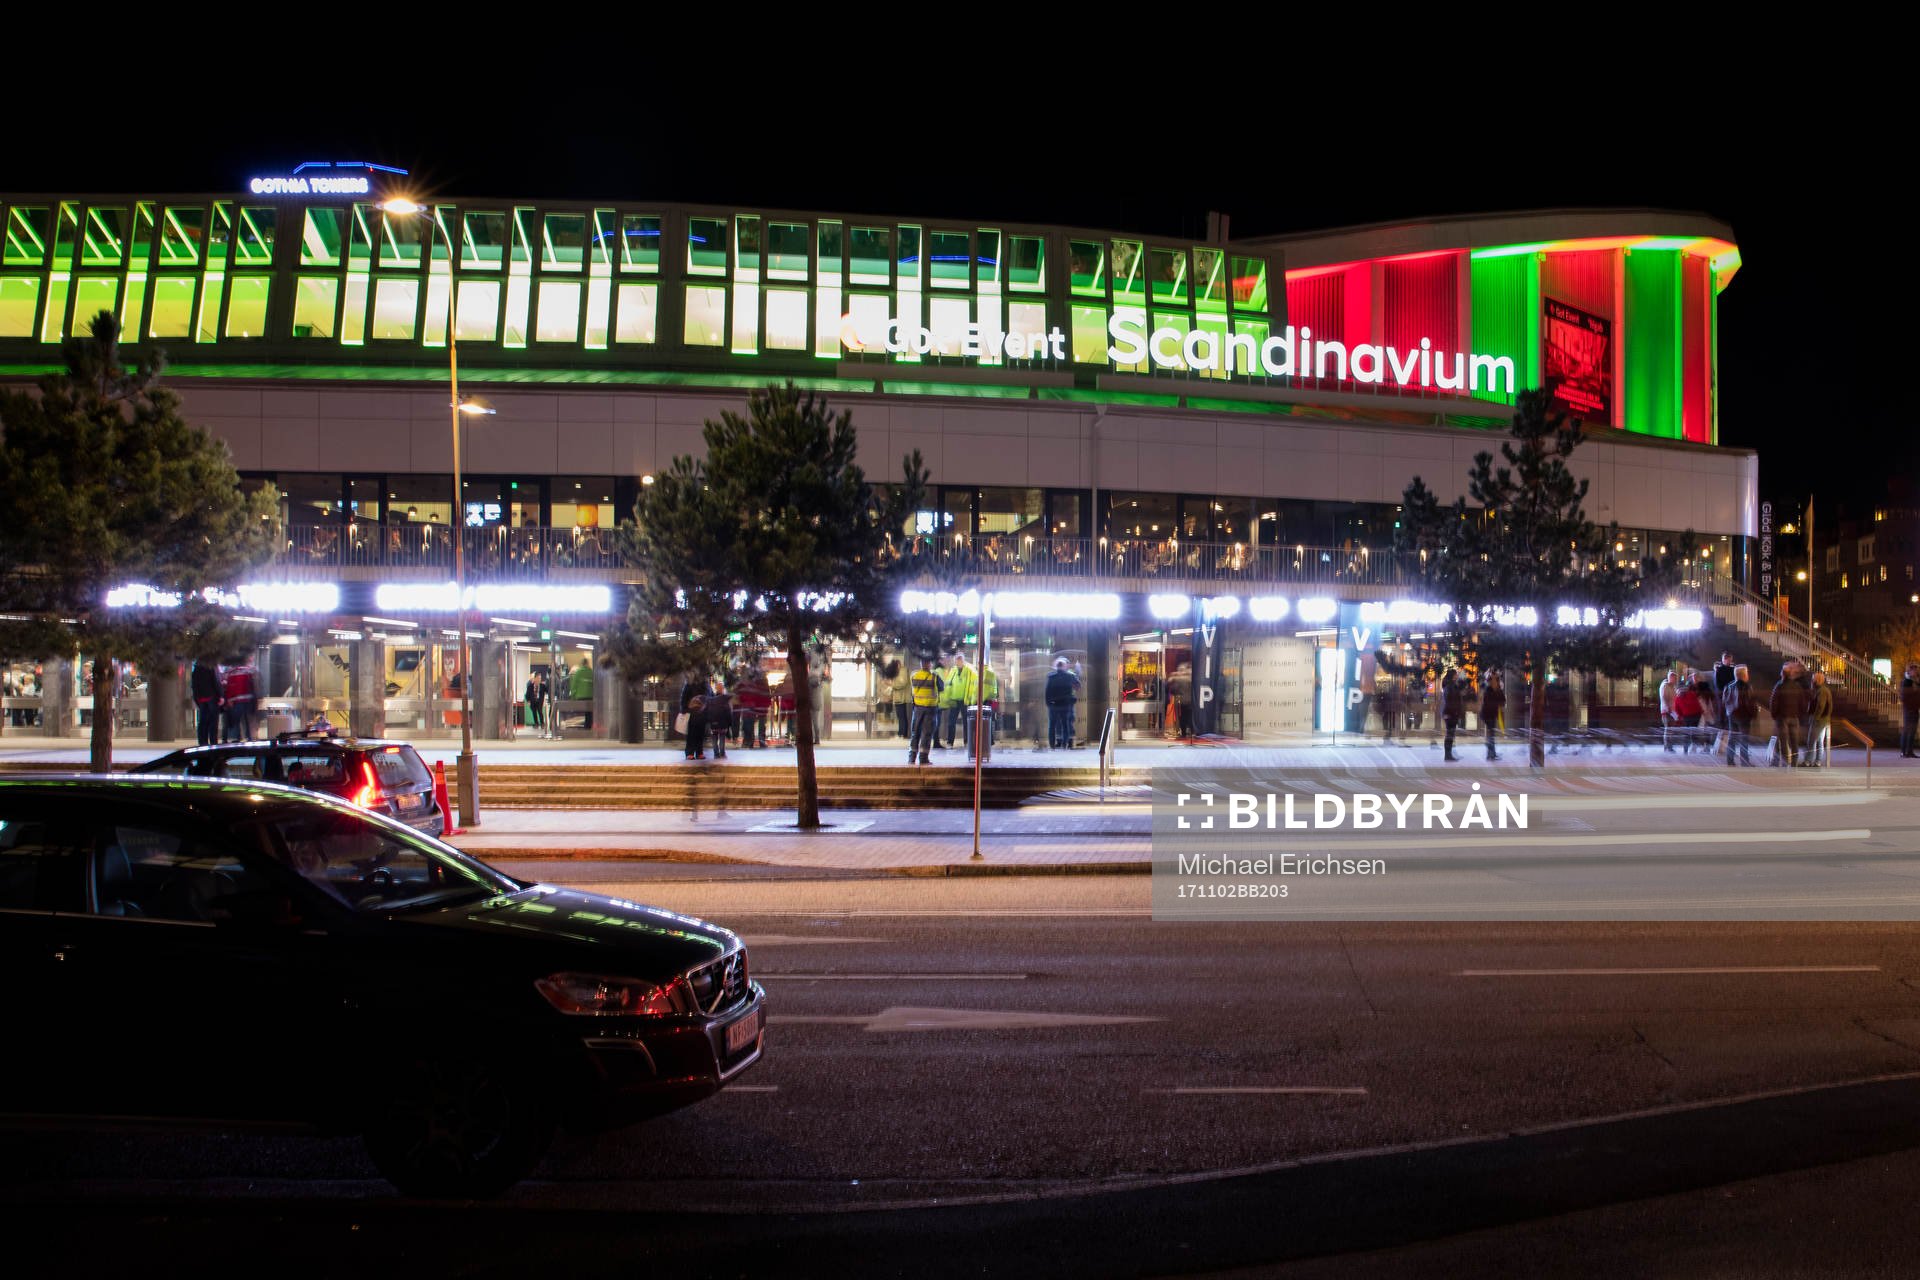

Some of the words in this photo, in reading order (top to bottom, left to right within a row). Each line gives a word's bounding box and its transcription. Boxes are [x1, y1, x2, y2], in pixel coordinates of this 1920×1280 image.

[251, 178, 309, 194] GOTHIA
[310, 178, 368, 194] TOWERS
[962, 322, 1066, 360] Event
[1107, 307, 1514, 394] Scandinavium
[1761, 502, 1772, 533] Glöd
[1761, 536, 1772, 560] Kök
[1761, 562, 1772, 572] &
[1761, 575, 1772, 597] Bar
